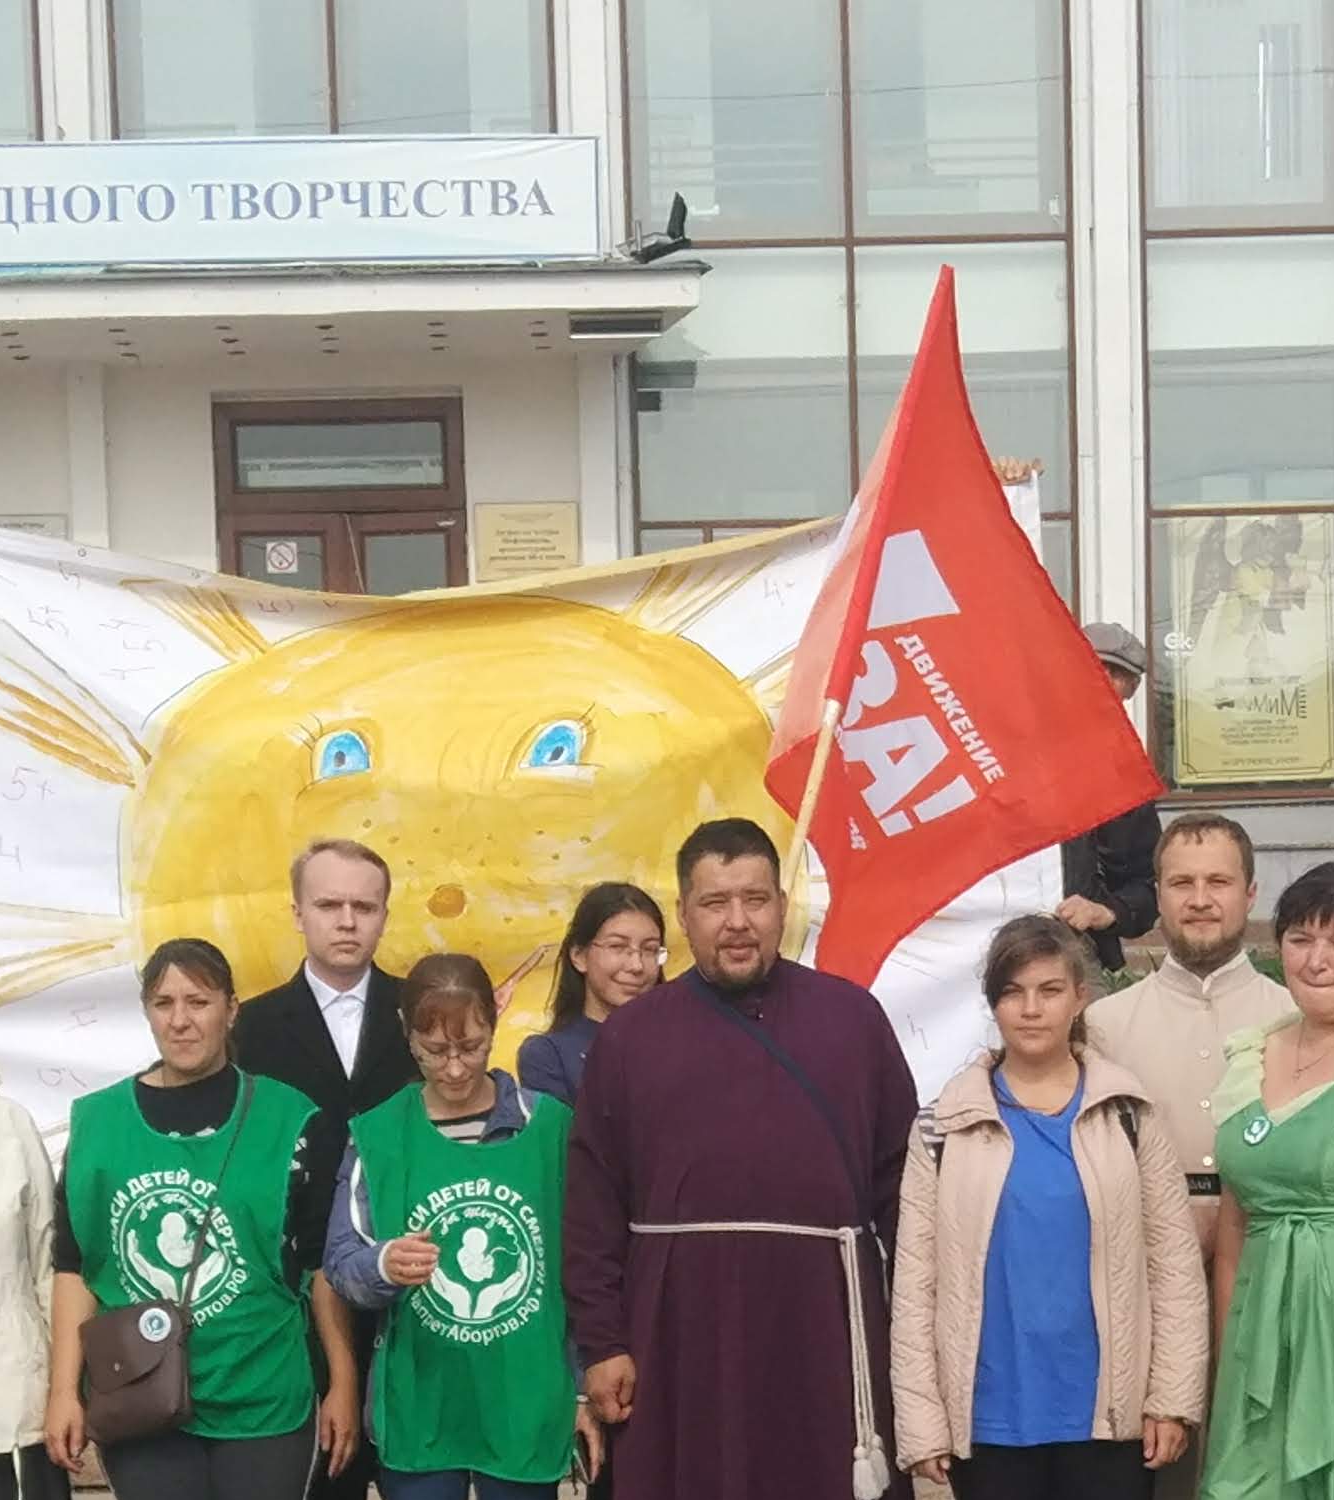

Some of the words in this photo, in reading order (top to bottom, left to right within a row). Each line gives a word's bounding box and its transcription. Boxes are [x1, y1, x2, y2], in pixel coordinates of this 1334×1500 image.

[188, 176, 555, 224] ТВОРЧЕСТВА
[893, 634, 1006, 785] ДВИЖЕНИЕ
[126, 1167, 191, 1200] ДЕТЕЙ
[191, 1180, 218, 1199] ОТ
[427, 1177, 492, 1214] ДЕТЕЙ
[494, 1184, 524, 1207] ОТ
[518, 1205, 547, 1286] СМЕРТИ
